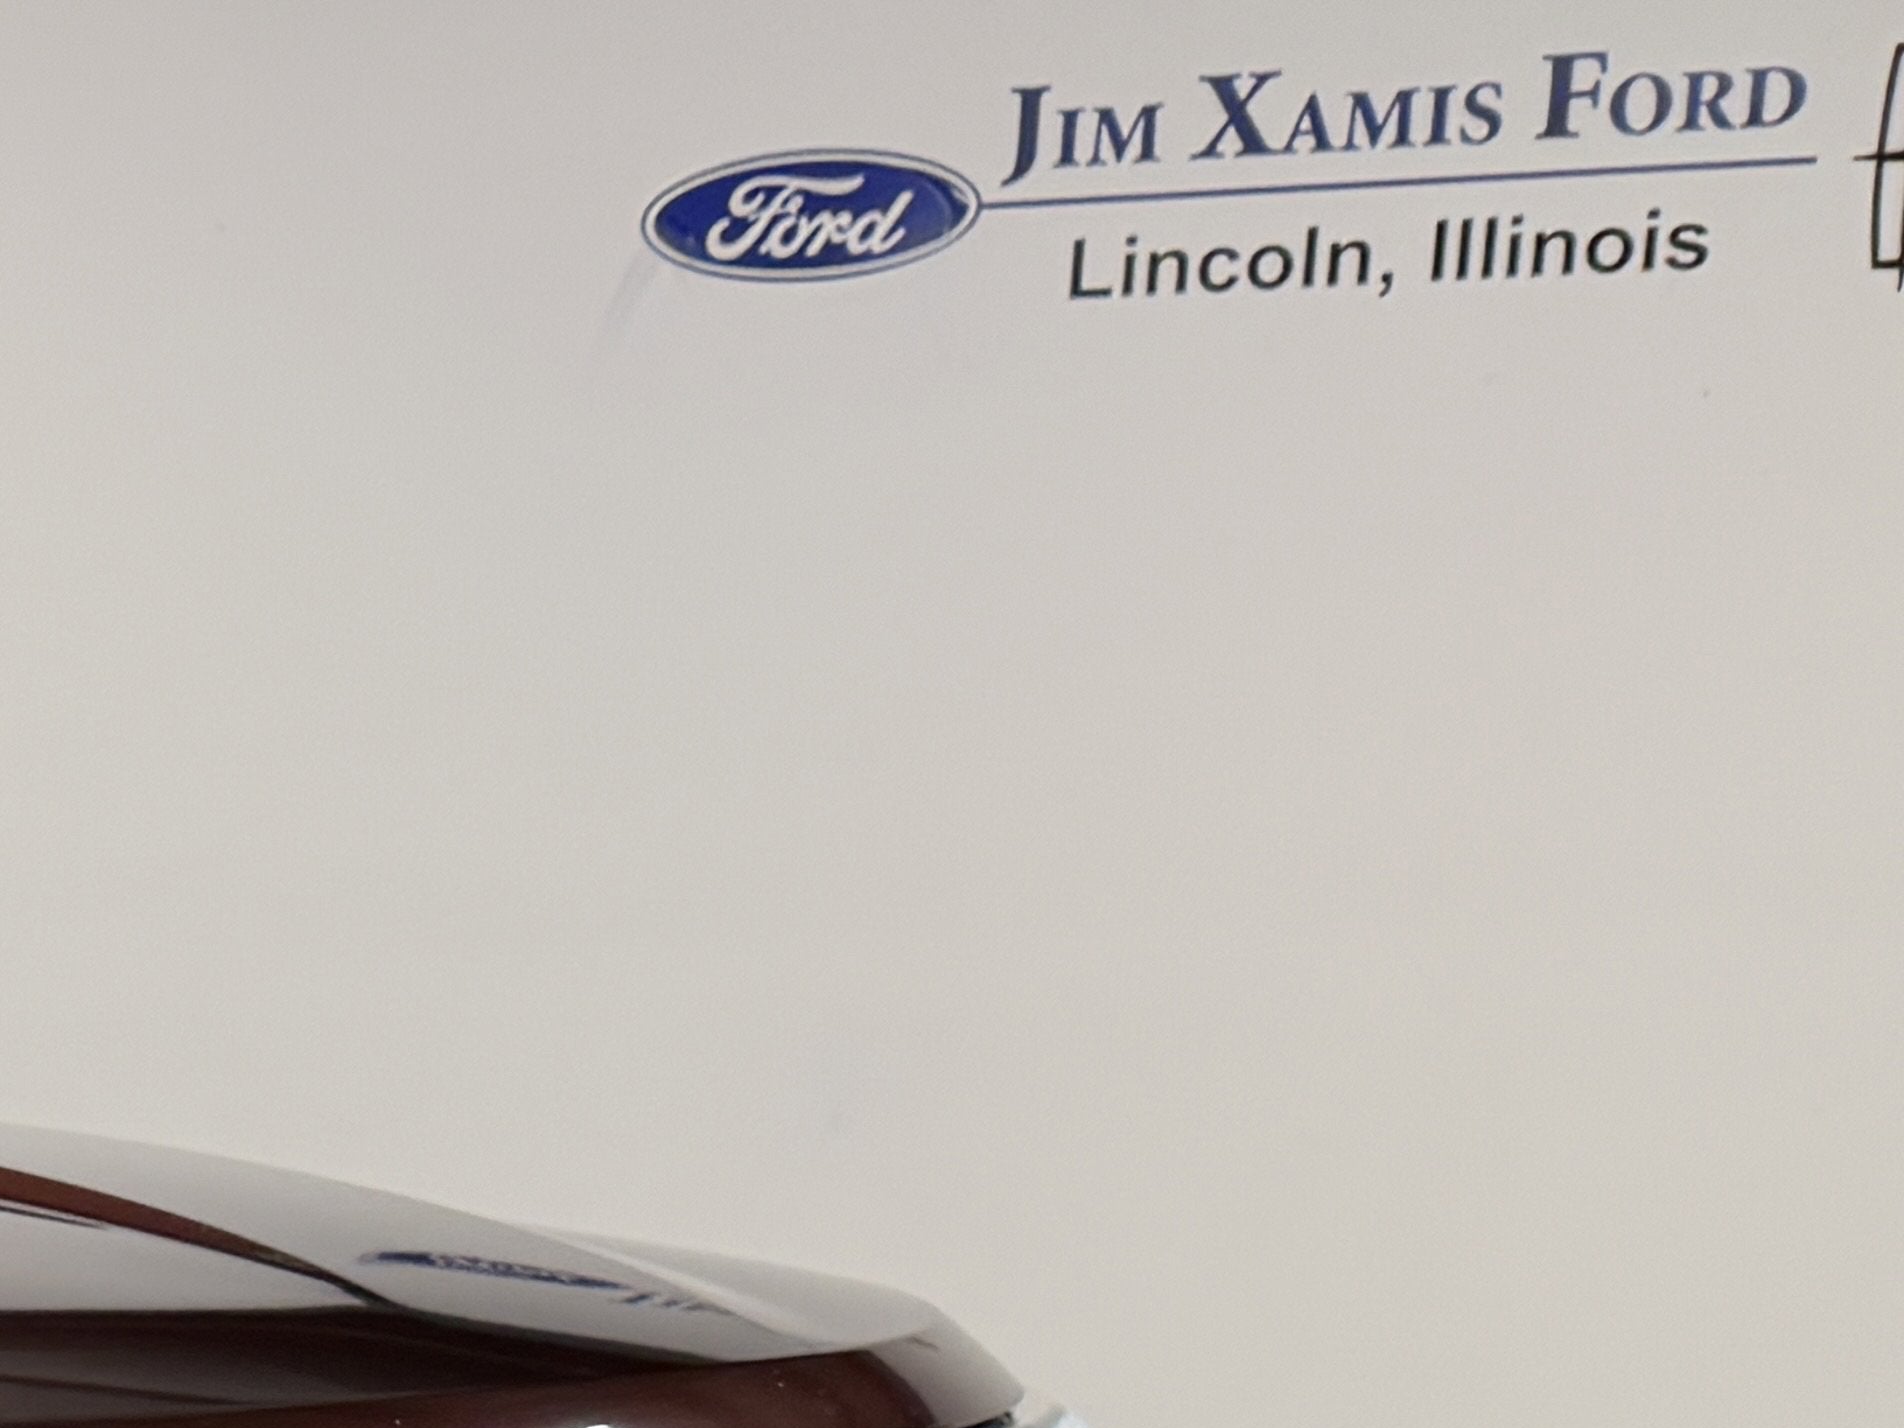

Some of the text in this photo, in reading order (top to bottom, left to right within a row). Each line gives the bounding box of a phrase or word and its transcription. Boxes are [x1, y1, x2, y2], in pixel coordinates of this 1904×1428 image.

[1001, 52, 1807, 187] JIM XAMIS FORD
[705, 173, 914, 262] Ford
[1069, 208, 1708, 300] Lincoln, Illinois
